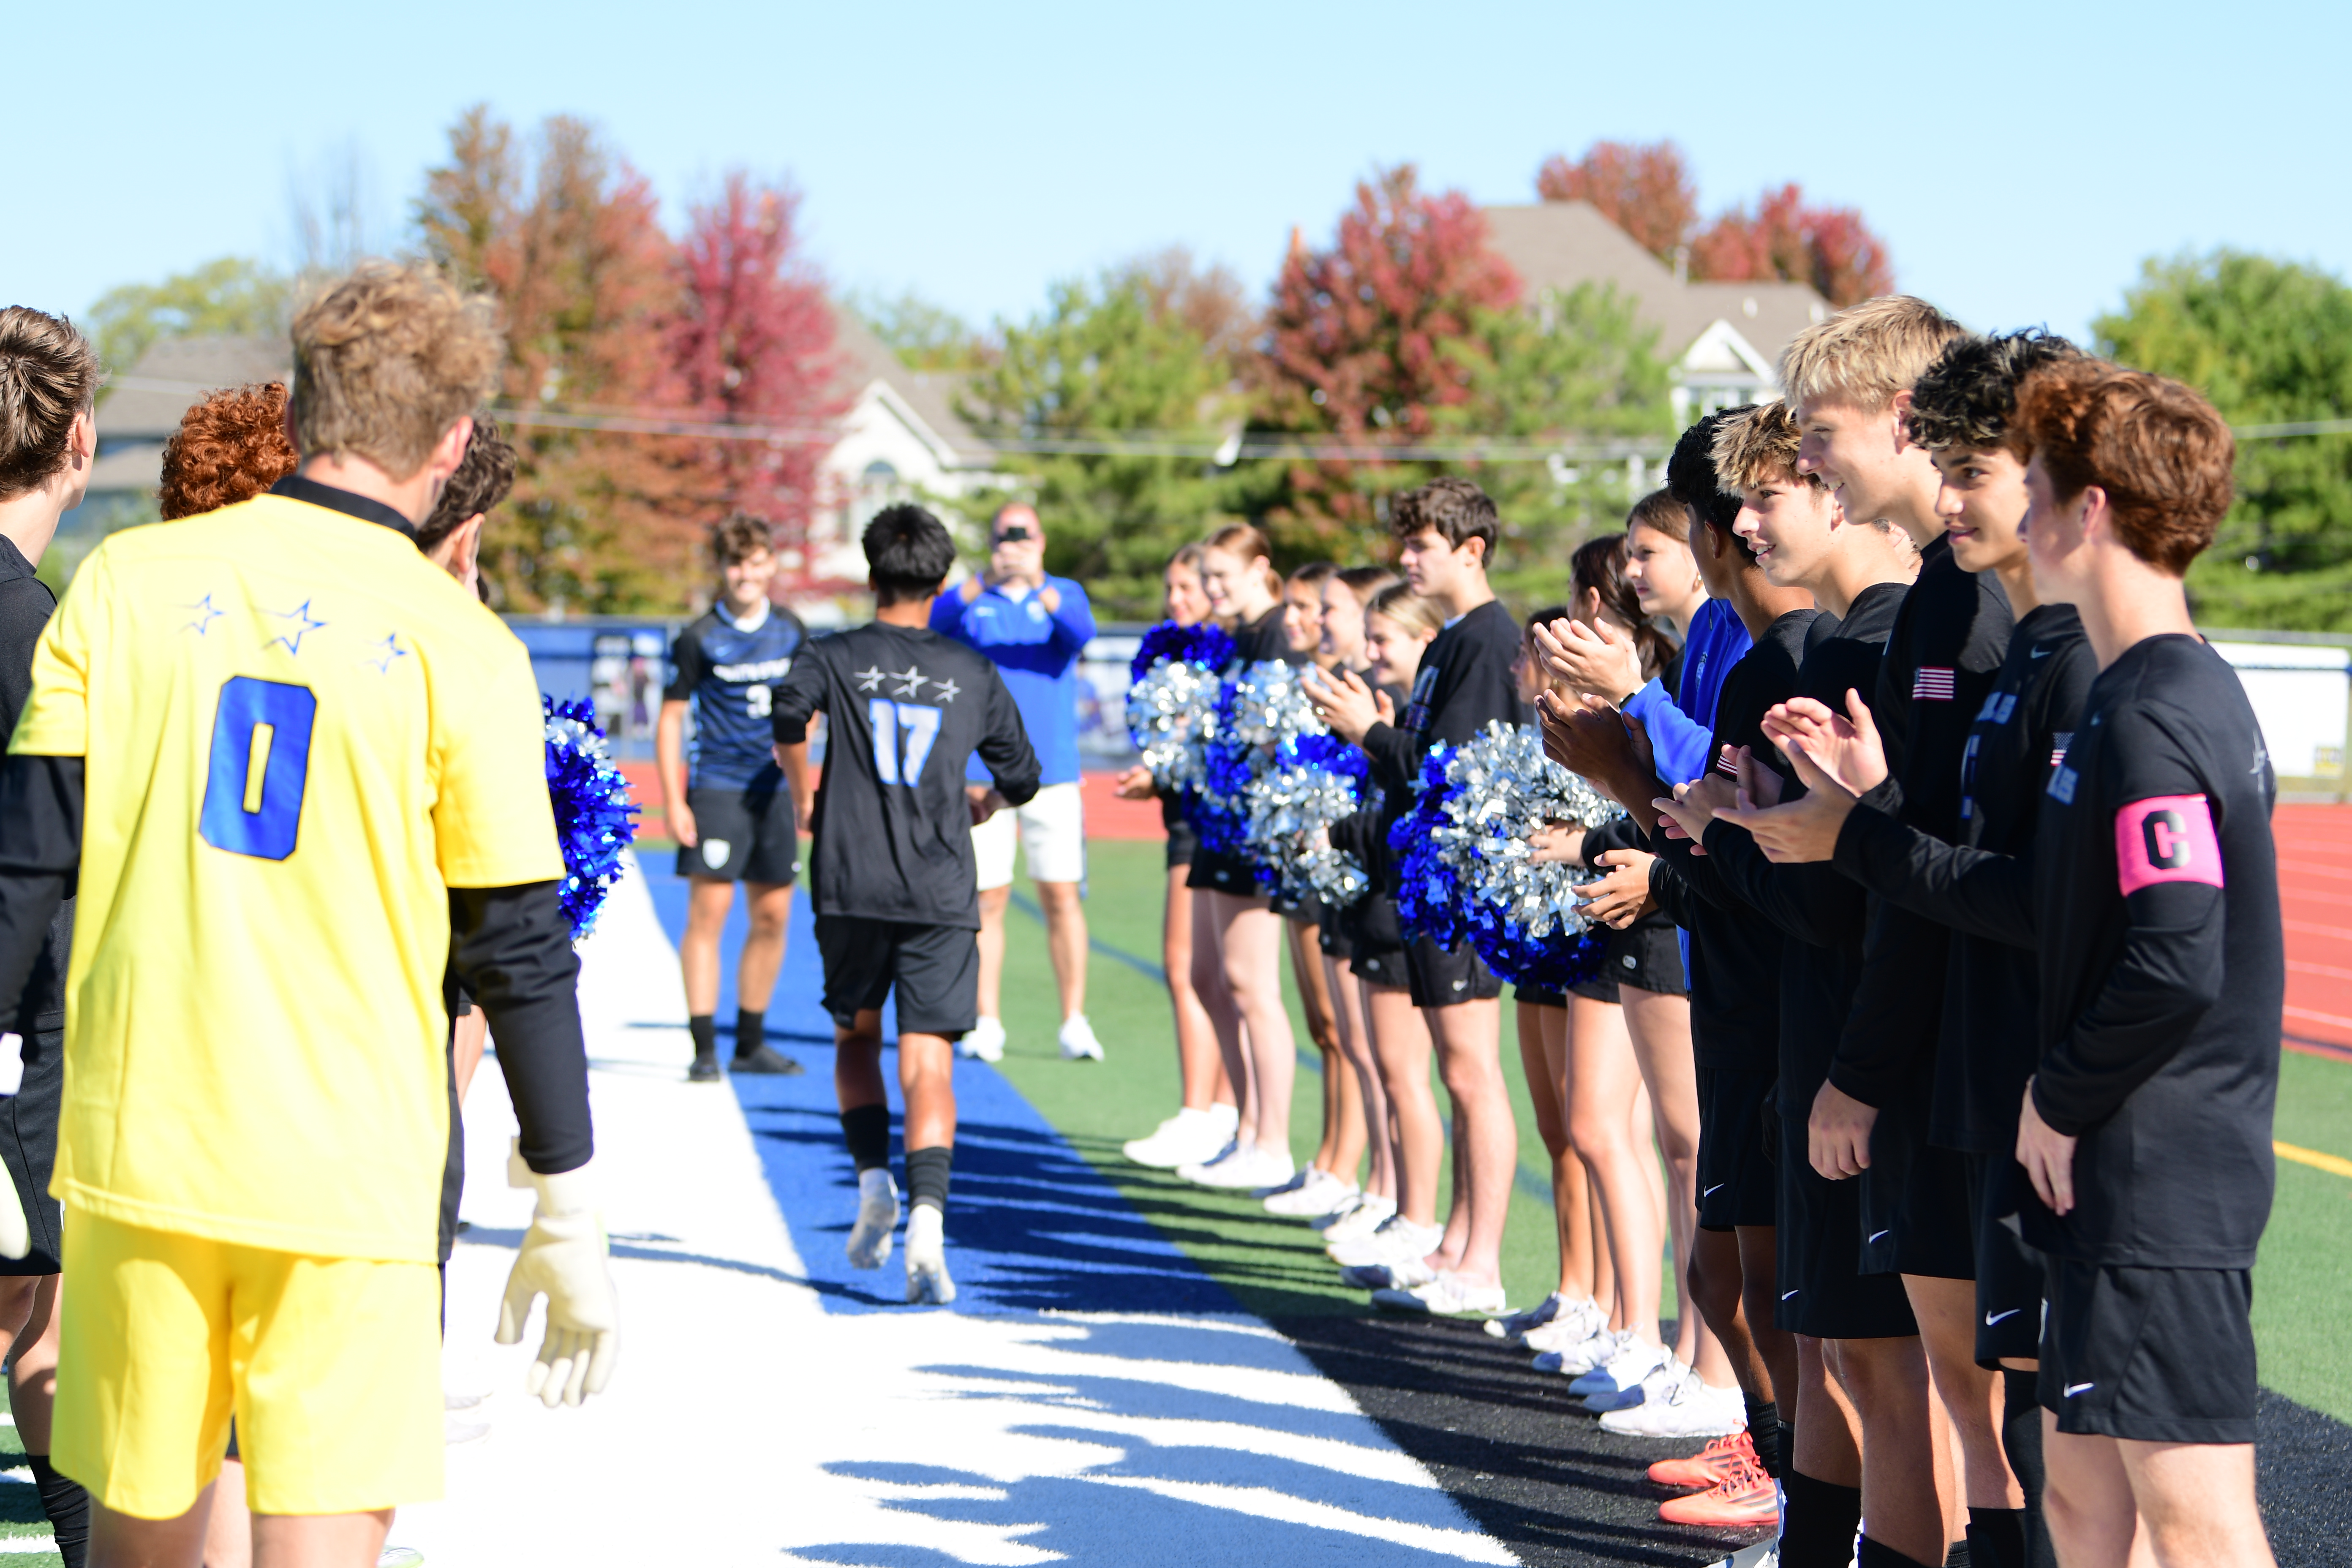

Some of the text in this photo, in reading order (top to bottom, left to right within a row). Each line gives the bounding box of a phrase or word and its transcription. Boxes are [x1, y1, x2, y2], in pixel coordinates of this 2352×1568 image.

[199, 675, 317, 861] 0
[869, 698, 942, 788] 17
[2142, 810, 2191, 870] C
